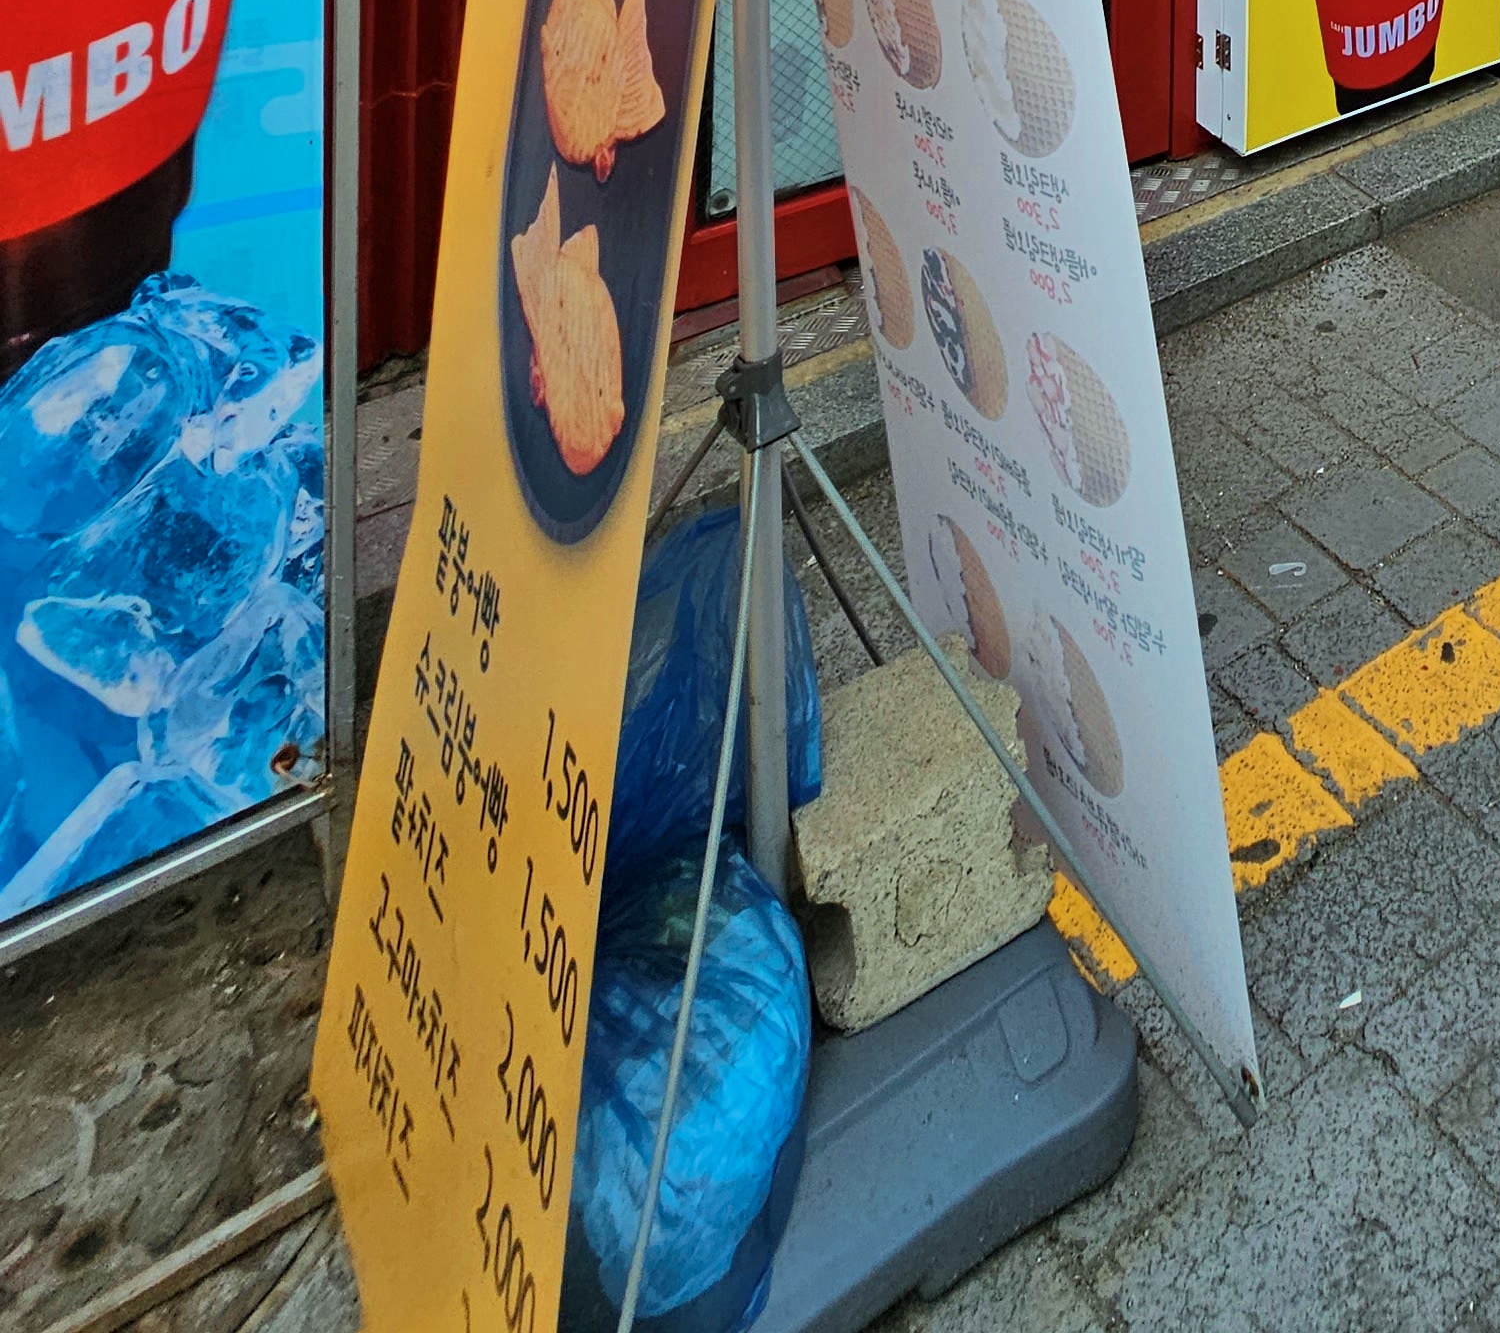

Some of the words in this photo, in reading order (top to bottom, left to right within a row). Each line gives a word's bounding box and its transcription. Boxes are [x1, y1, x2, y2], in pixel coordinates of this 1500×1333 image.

[415, 632, 508, 874] 슈크림붕어빵
[521, 856, 578, 1048] 1,500
[435, 494, 500, 673] 팥붕어빵
[542, 708, 599, 886] 1,500
[347, 983, 410, 1204] 피자치즈
[498, 1001, 558, 1211] 2,000
